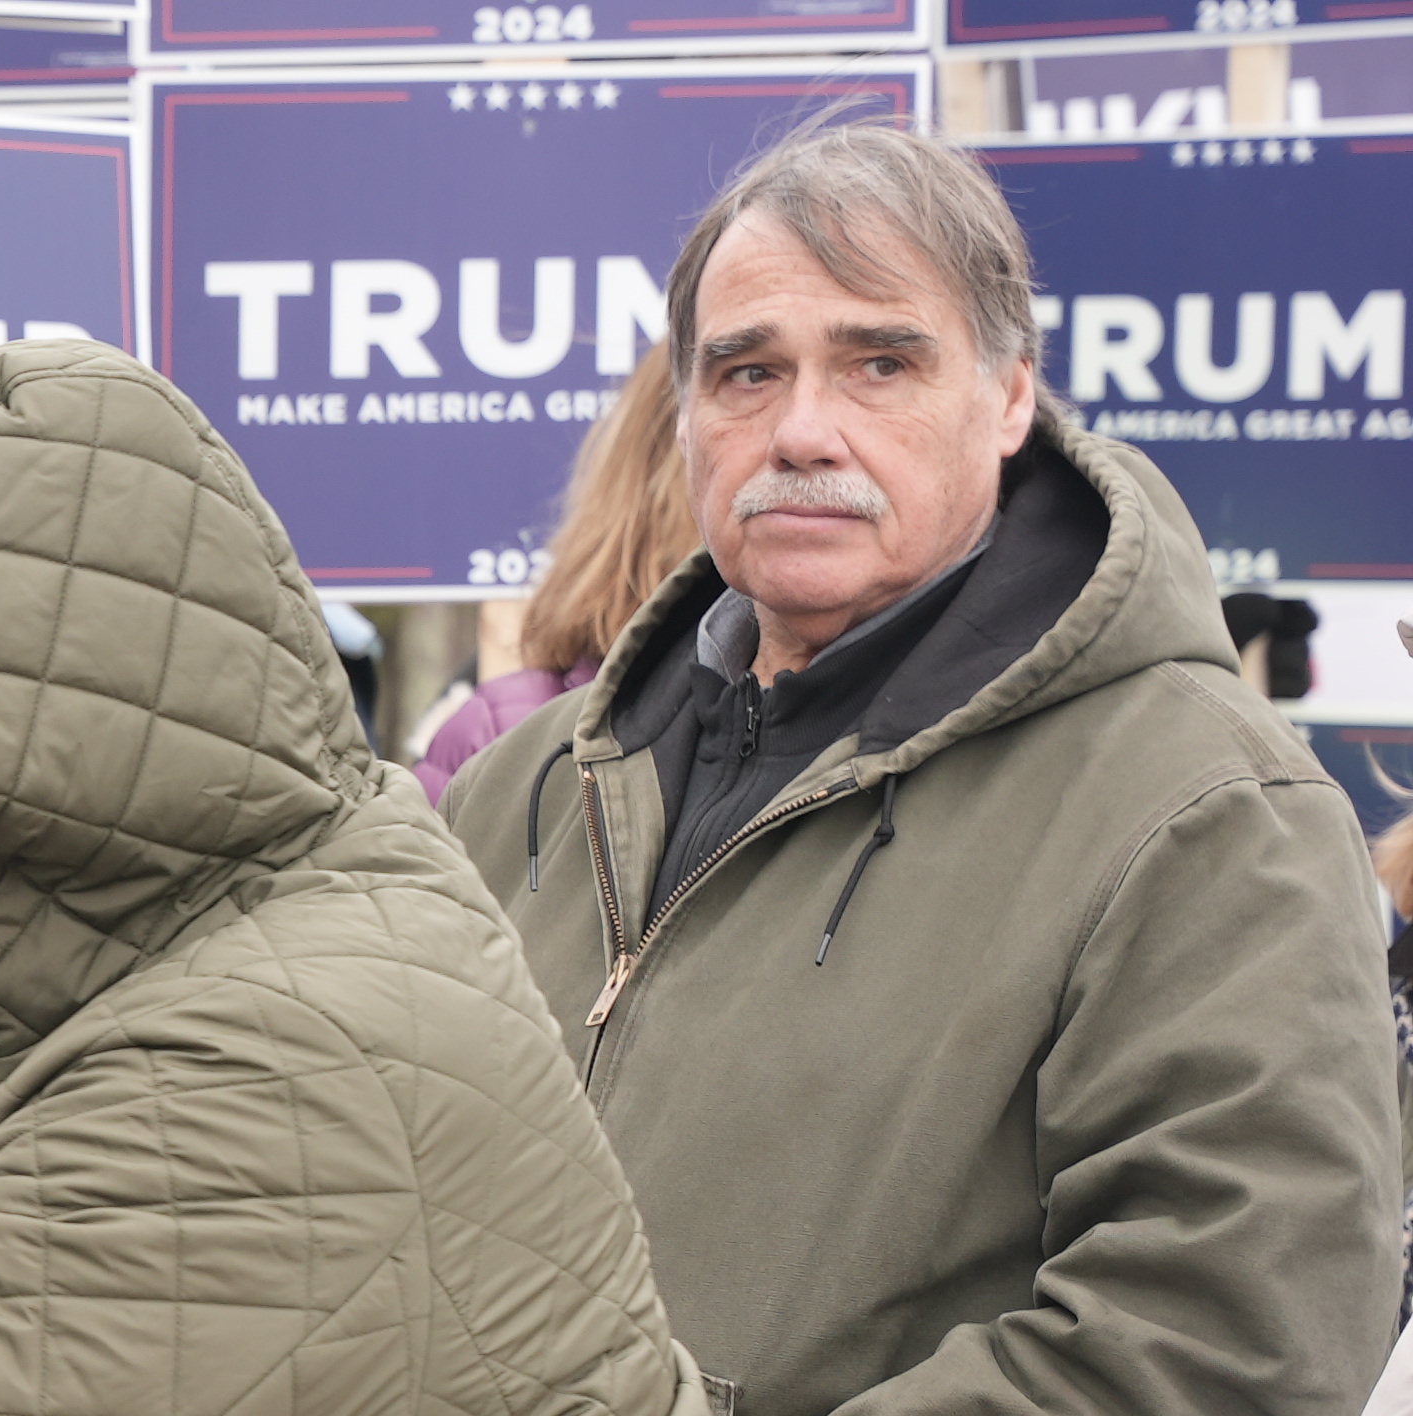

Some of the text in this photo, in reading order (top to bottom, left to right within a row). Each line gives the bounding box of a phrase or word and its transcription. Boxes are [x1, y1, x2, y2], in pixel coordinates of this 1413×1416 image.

[472, 4, 596, 42] 2024
[1032, 289, 1406, 403] RUM
[237, 394, 348, 426] MAKE
[358, 391, 534, 425] AMERICA
[1091, 410, 1240, 441] AMERICA
[1243, 408, 1358, 441] GREAT
[467, 547, 554, 584] 202
[1207, 547, 1280, 584] 024
